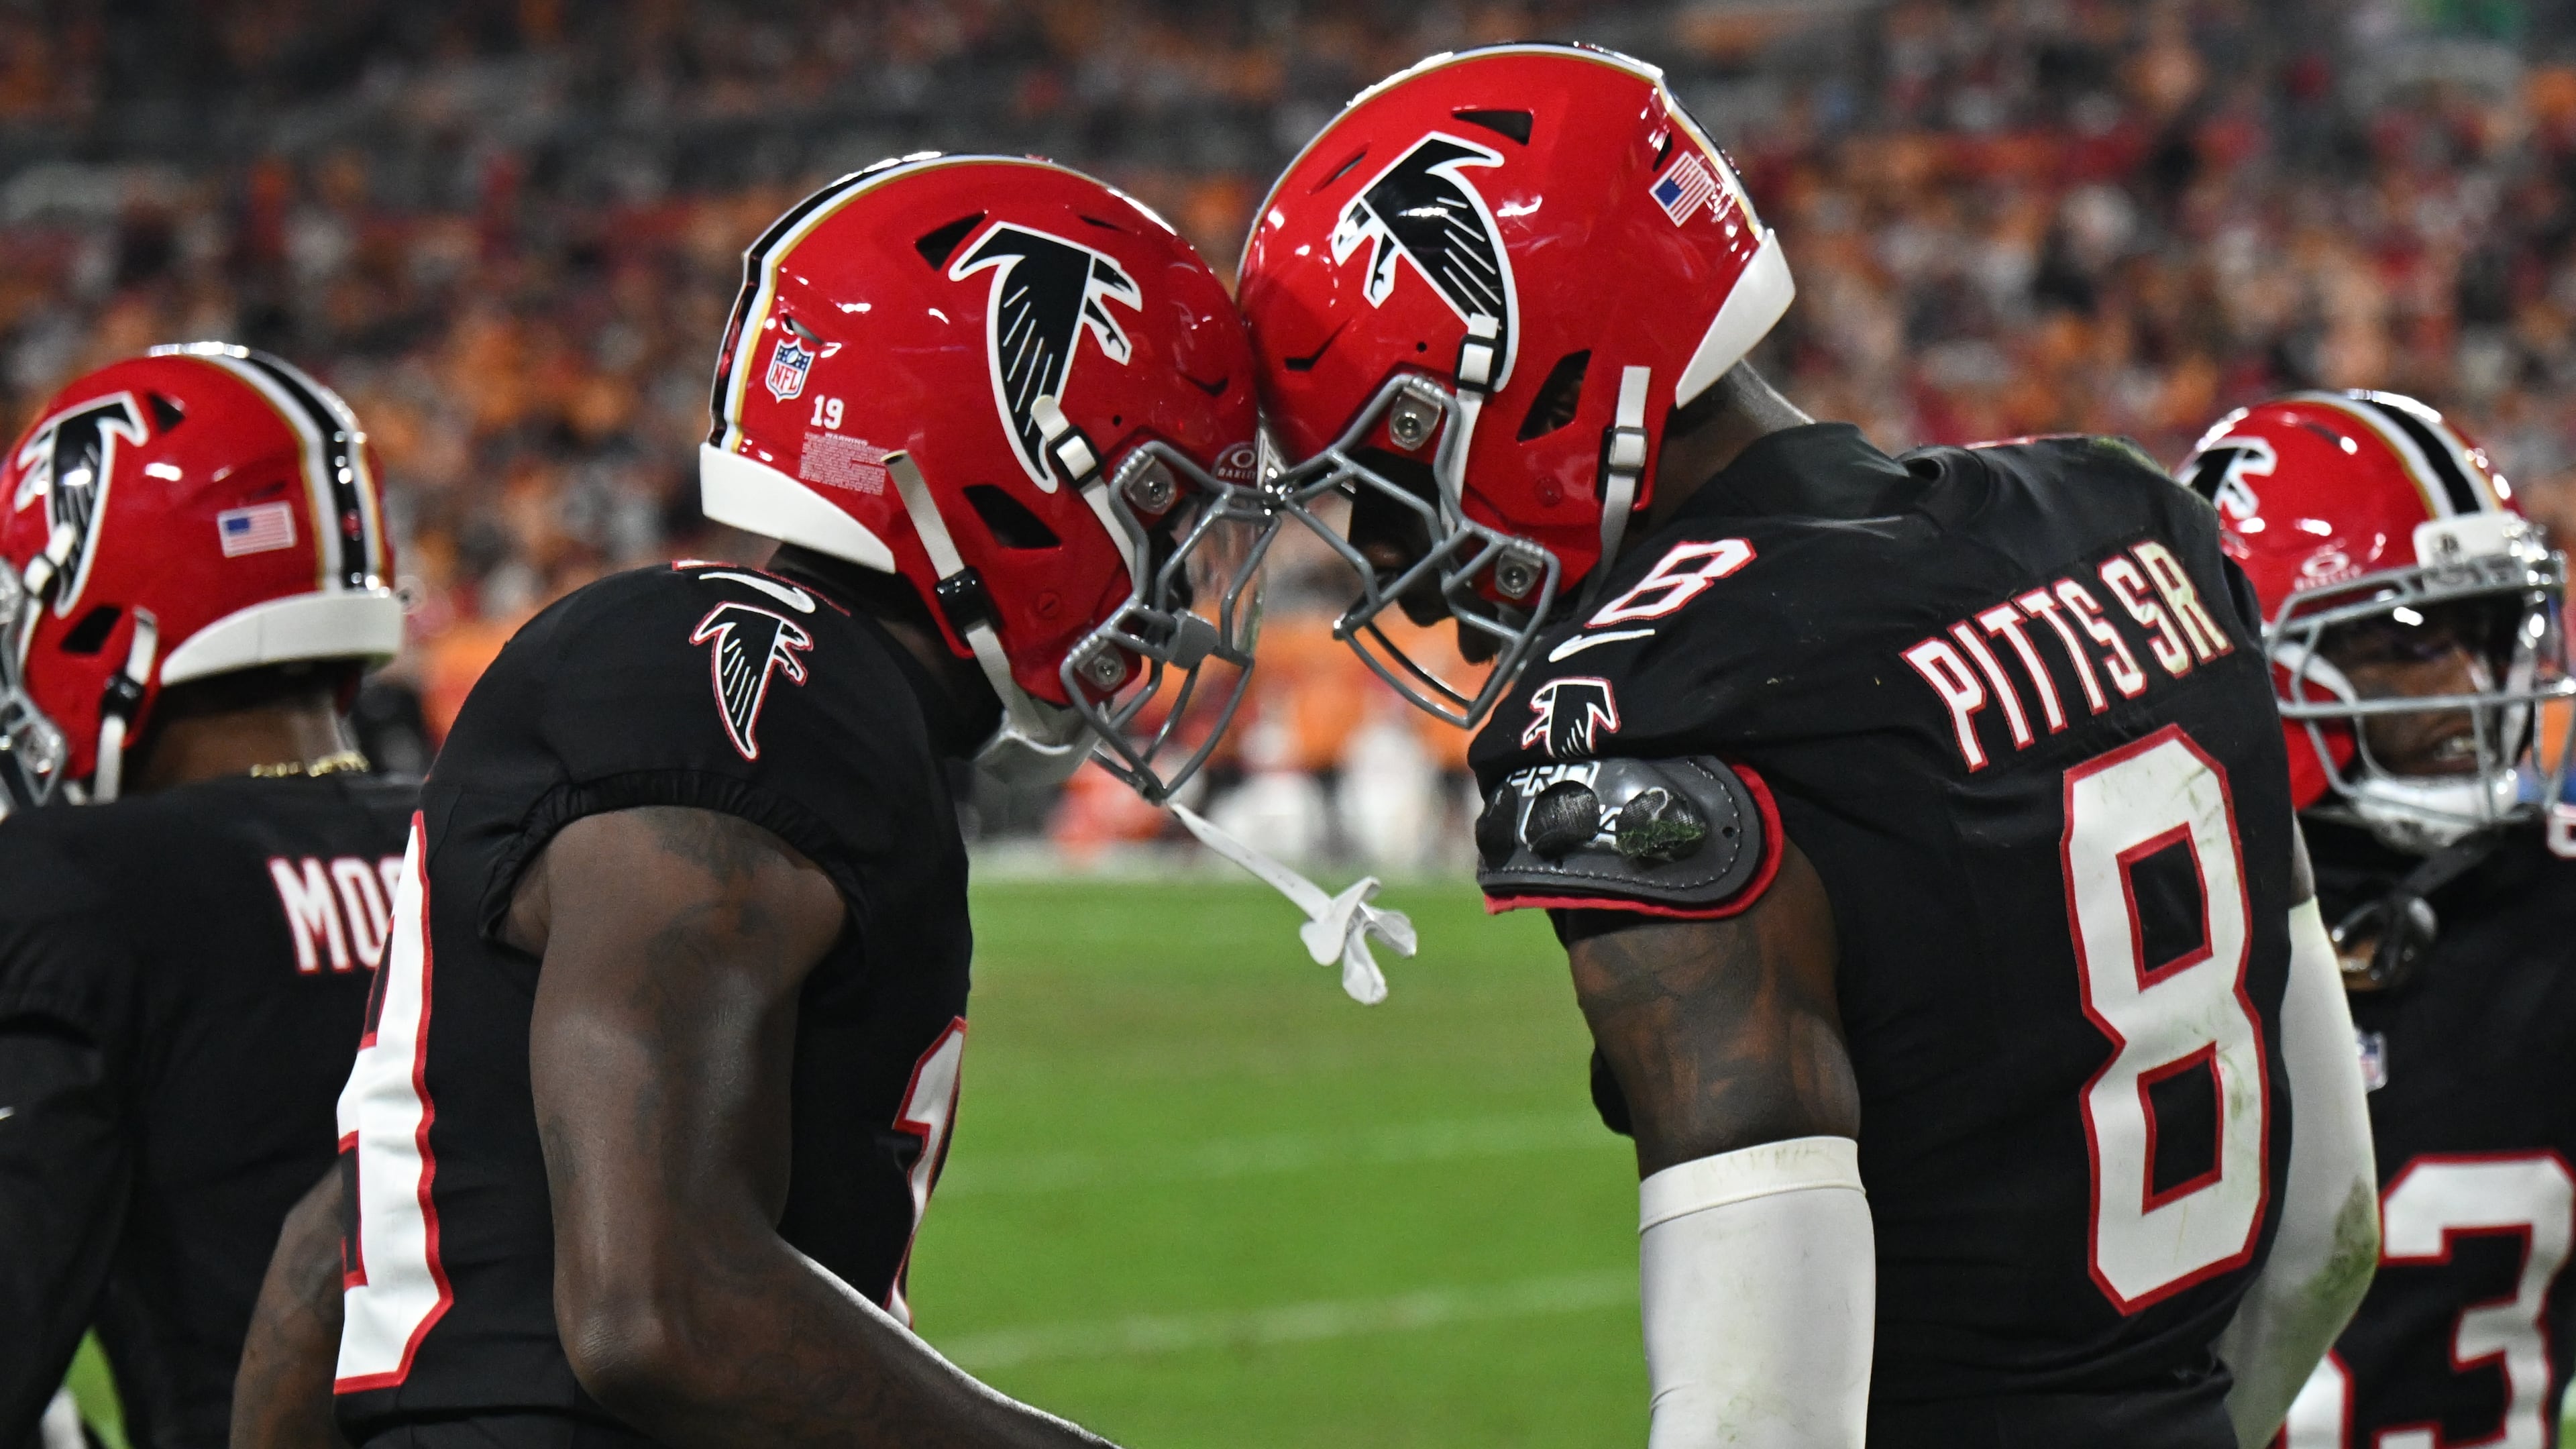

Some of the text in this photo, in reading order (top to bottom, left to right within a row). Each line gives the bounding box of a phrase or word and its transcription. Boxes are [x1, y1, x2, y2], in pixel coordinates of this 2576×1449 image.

[771, 363, 798, 391] NFL
[810, 394, 845, 430] 19
[824, 431, 869, 446] WARNING
[1583, 537, 1758, 629] 8
[1899, 539, 2235, 773] PITTS SR
[268, 854, 405, 975] MO
[2059, 723, 2270, 1316] 8
